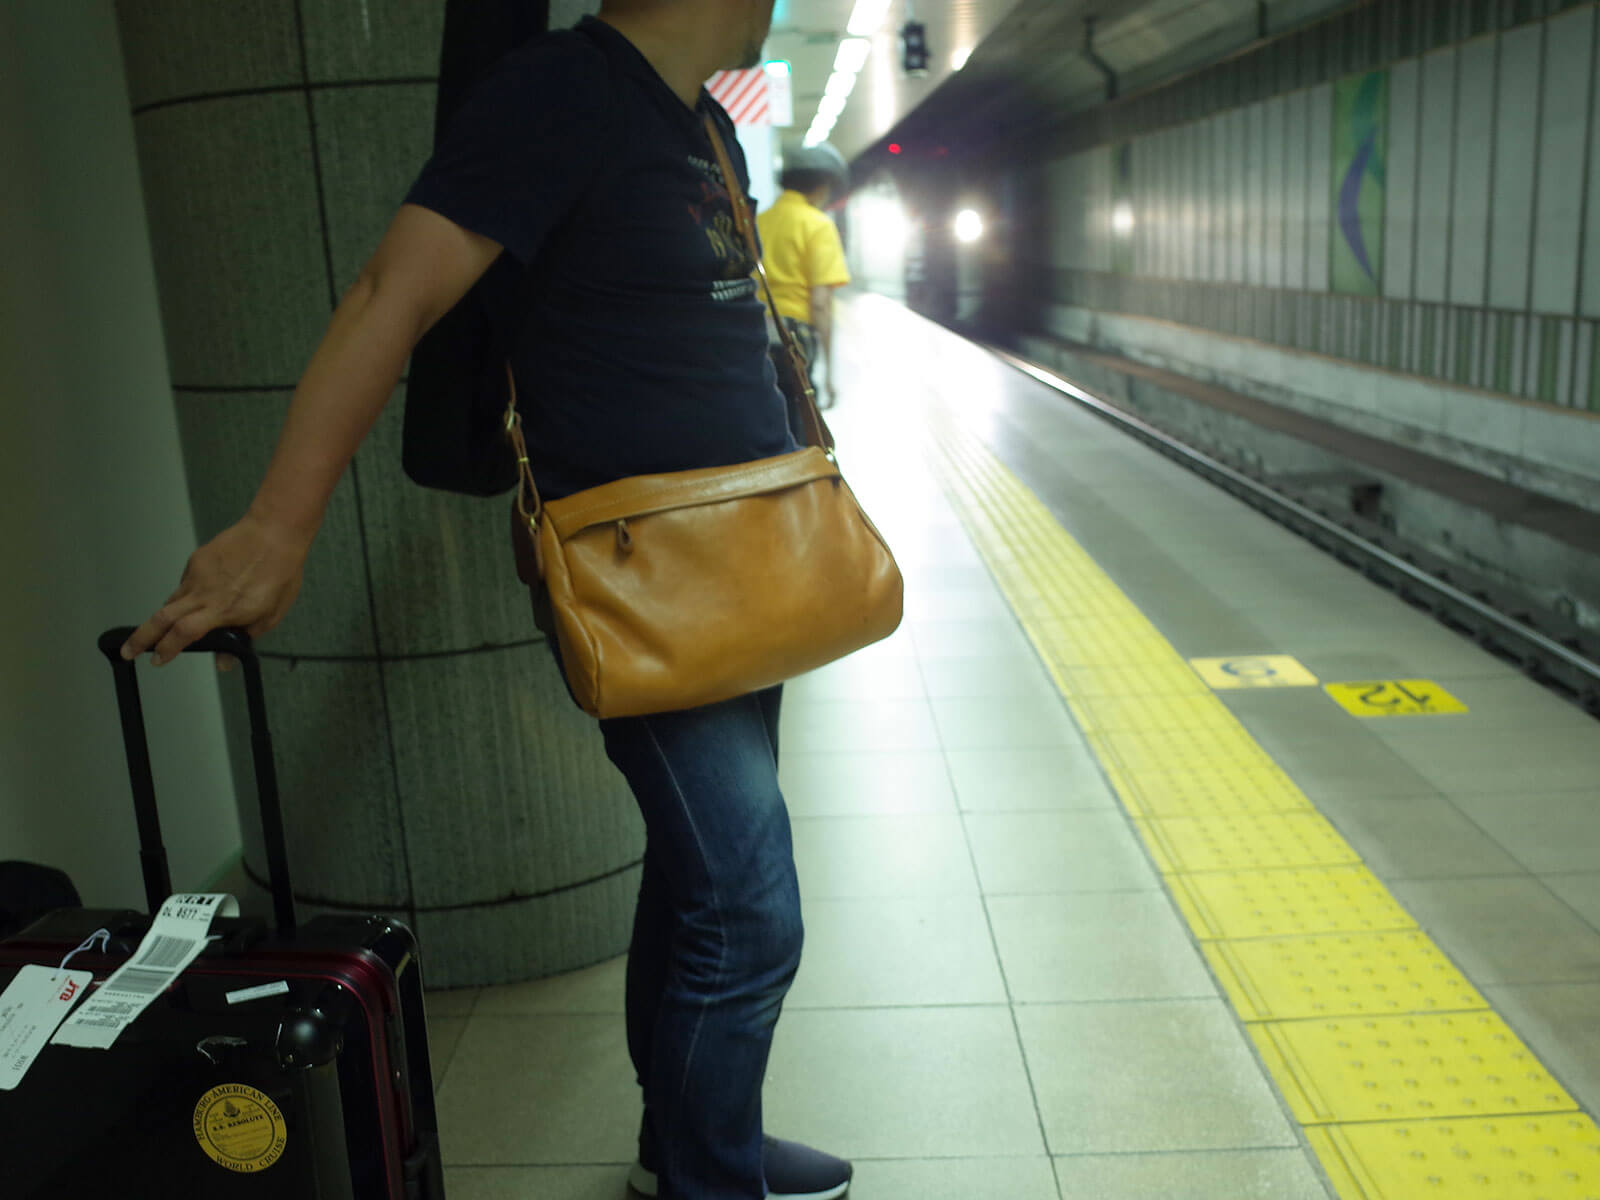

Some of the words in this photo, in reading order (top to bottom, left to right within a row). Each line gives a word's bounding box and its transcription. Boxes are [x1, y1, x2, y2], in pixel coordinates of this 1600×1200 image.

[59, 980, 79, 1002] JTB
[212, 1086, 263, 1100] AMERICAN
[265, 1100, 281, 1121] LINE
[217, 1155, 253, 1170] WORLD
[259, 1137, 285, 1167] CRUISE
